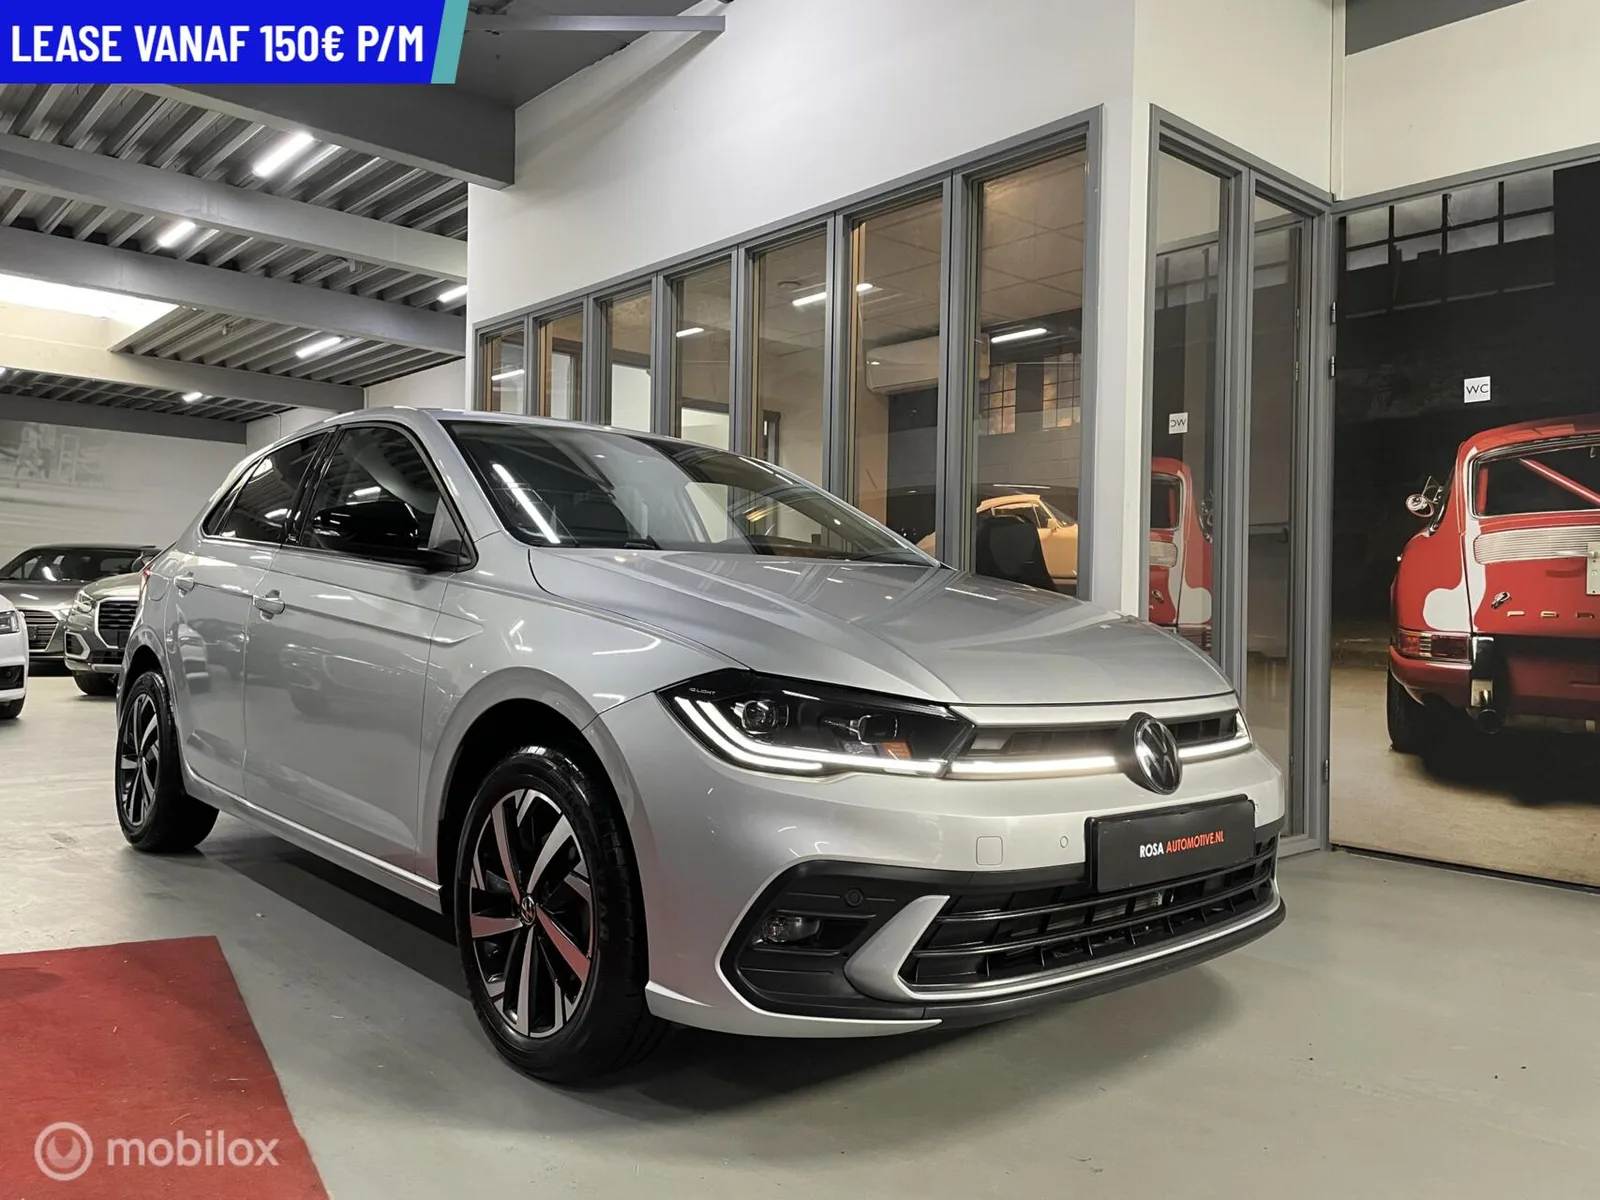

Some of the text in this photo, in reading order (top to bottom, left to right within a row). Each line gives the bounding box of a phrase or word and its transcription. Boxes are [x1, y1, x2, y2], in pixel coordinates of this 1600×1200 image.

[1466, 383, 1489, 394] WC
[1139, 830, 1224, 858] ROSA AUTOMOTIVE.NL
